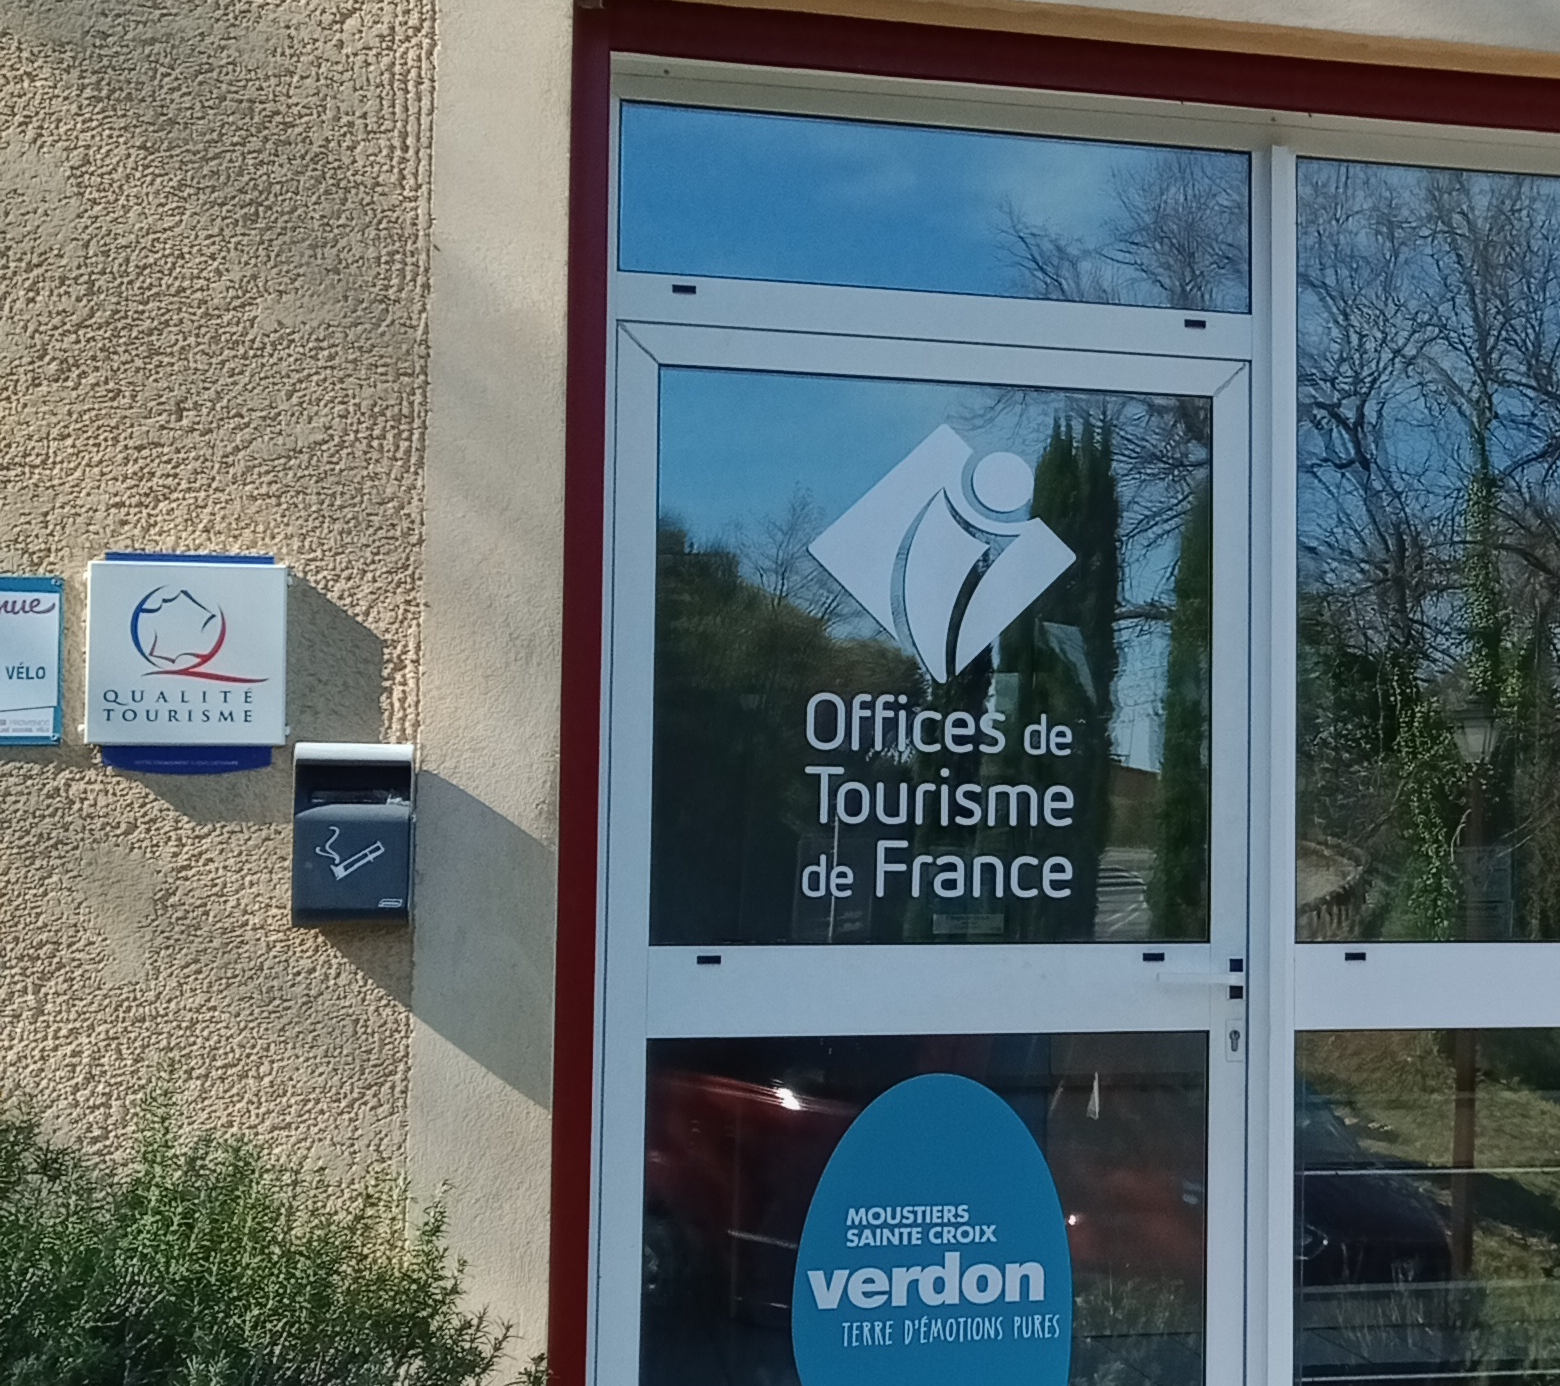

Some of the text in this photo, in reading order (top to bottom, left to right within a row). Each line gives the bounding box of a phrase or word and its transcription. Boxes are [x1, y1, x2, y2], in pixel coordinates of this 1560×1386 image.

[5, 661, 46, 680] VÉLO
[102, 687, 253, 706] QUALITÉ
[102, 707, 253, 724] TOURISME
[805, 692, 1073, 757] Offices de
[804, 765, 1075, 828] Tourisme
[801, 839, 1074, 899] de France
[846, 1204, 969, 1226] MOUSTIERS
[845, 1224, 997, 1248] SAINTE CROIX
[807, 1251, 1045, 1310] verdon
[842, 1313, 1061, 1348] TERRE D'ÉMOTIONS PURES
